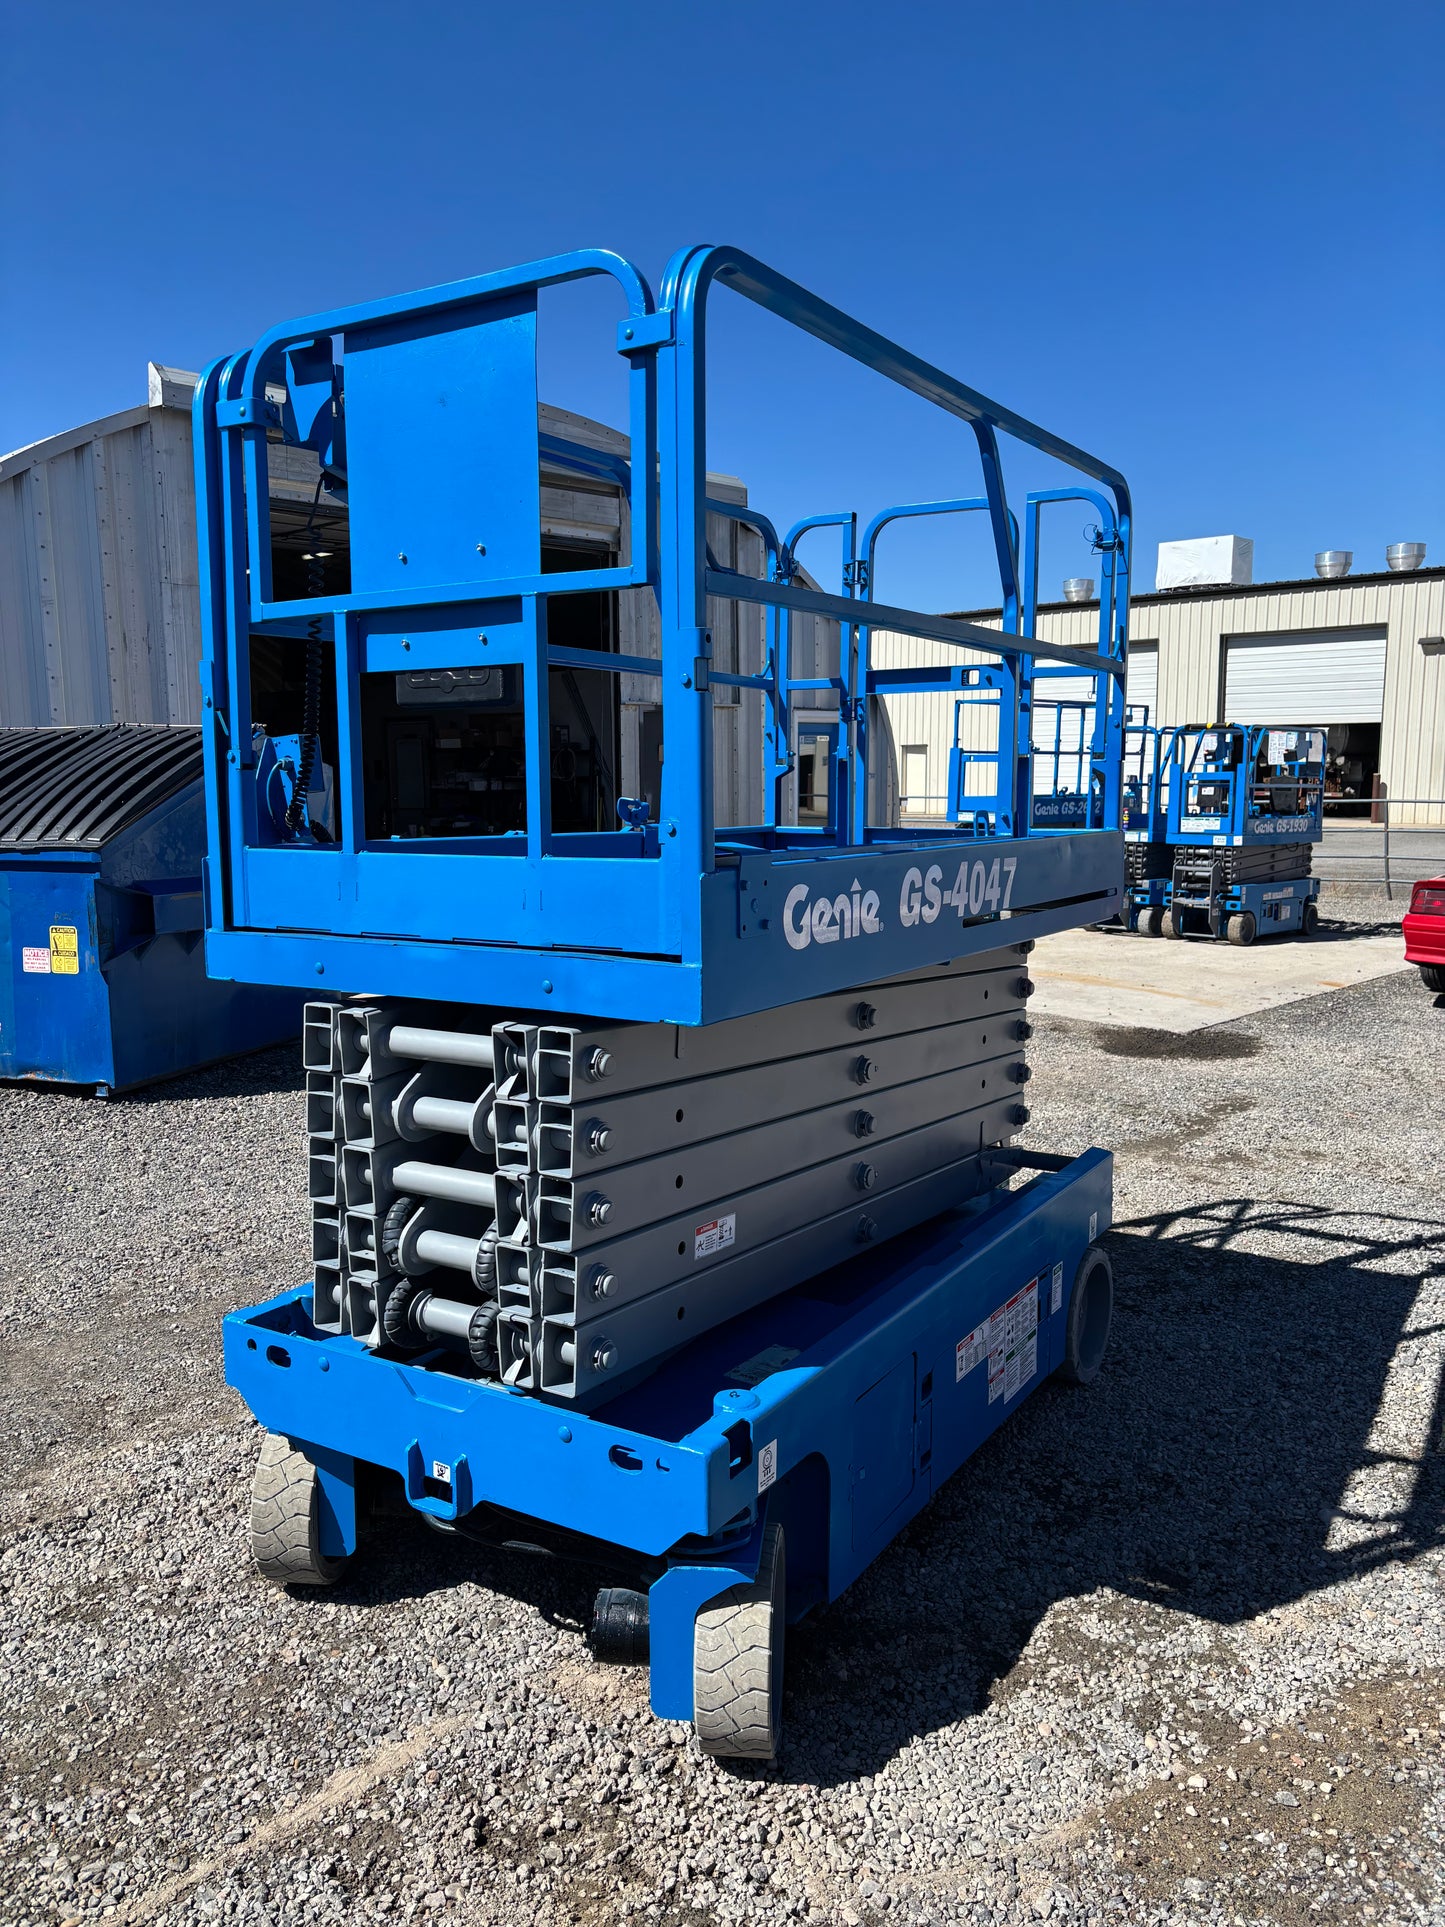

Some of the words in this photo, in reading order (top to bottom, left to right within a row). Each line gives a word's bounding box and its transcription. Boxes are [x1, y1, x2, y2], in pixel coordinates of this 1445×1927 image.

[1035, 803, 1059, 816] Genie
[1062, 801, 1101, 815] GS-262
[1254, 821, 1274, 834] Genie
[1277, 819, 1308, 833] GS-1930
[783, 878, 881, 950] Genie
[900, 857, 1017, 927] GS-4047
[24, 949, 49, 957] NOTICE
